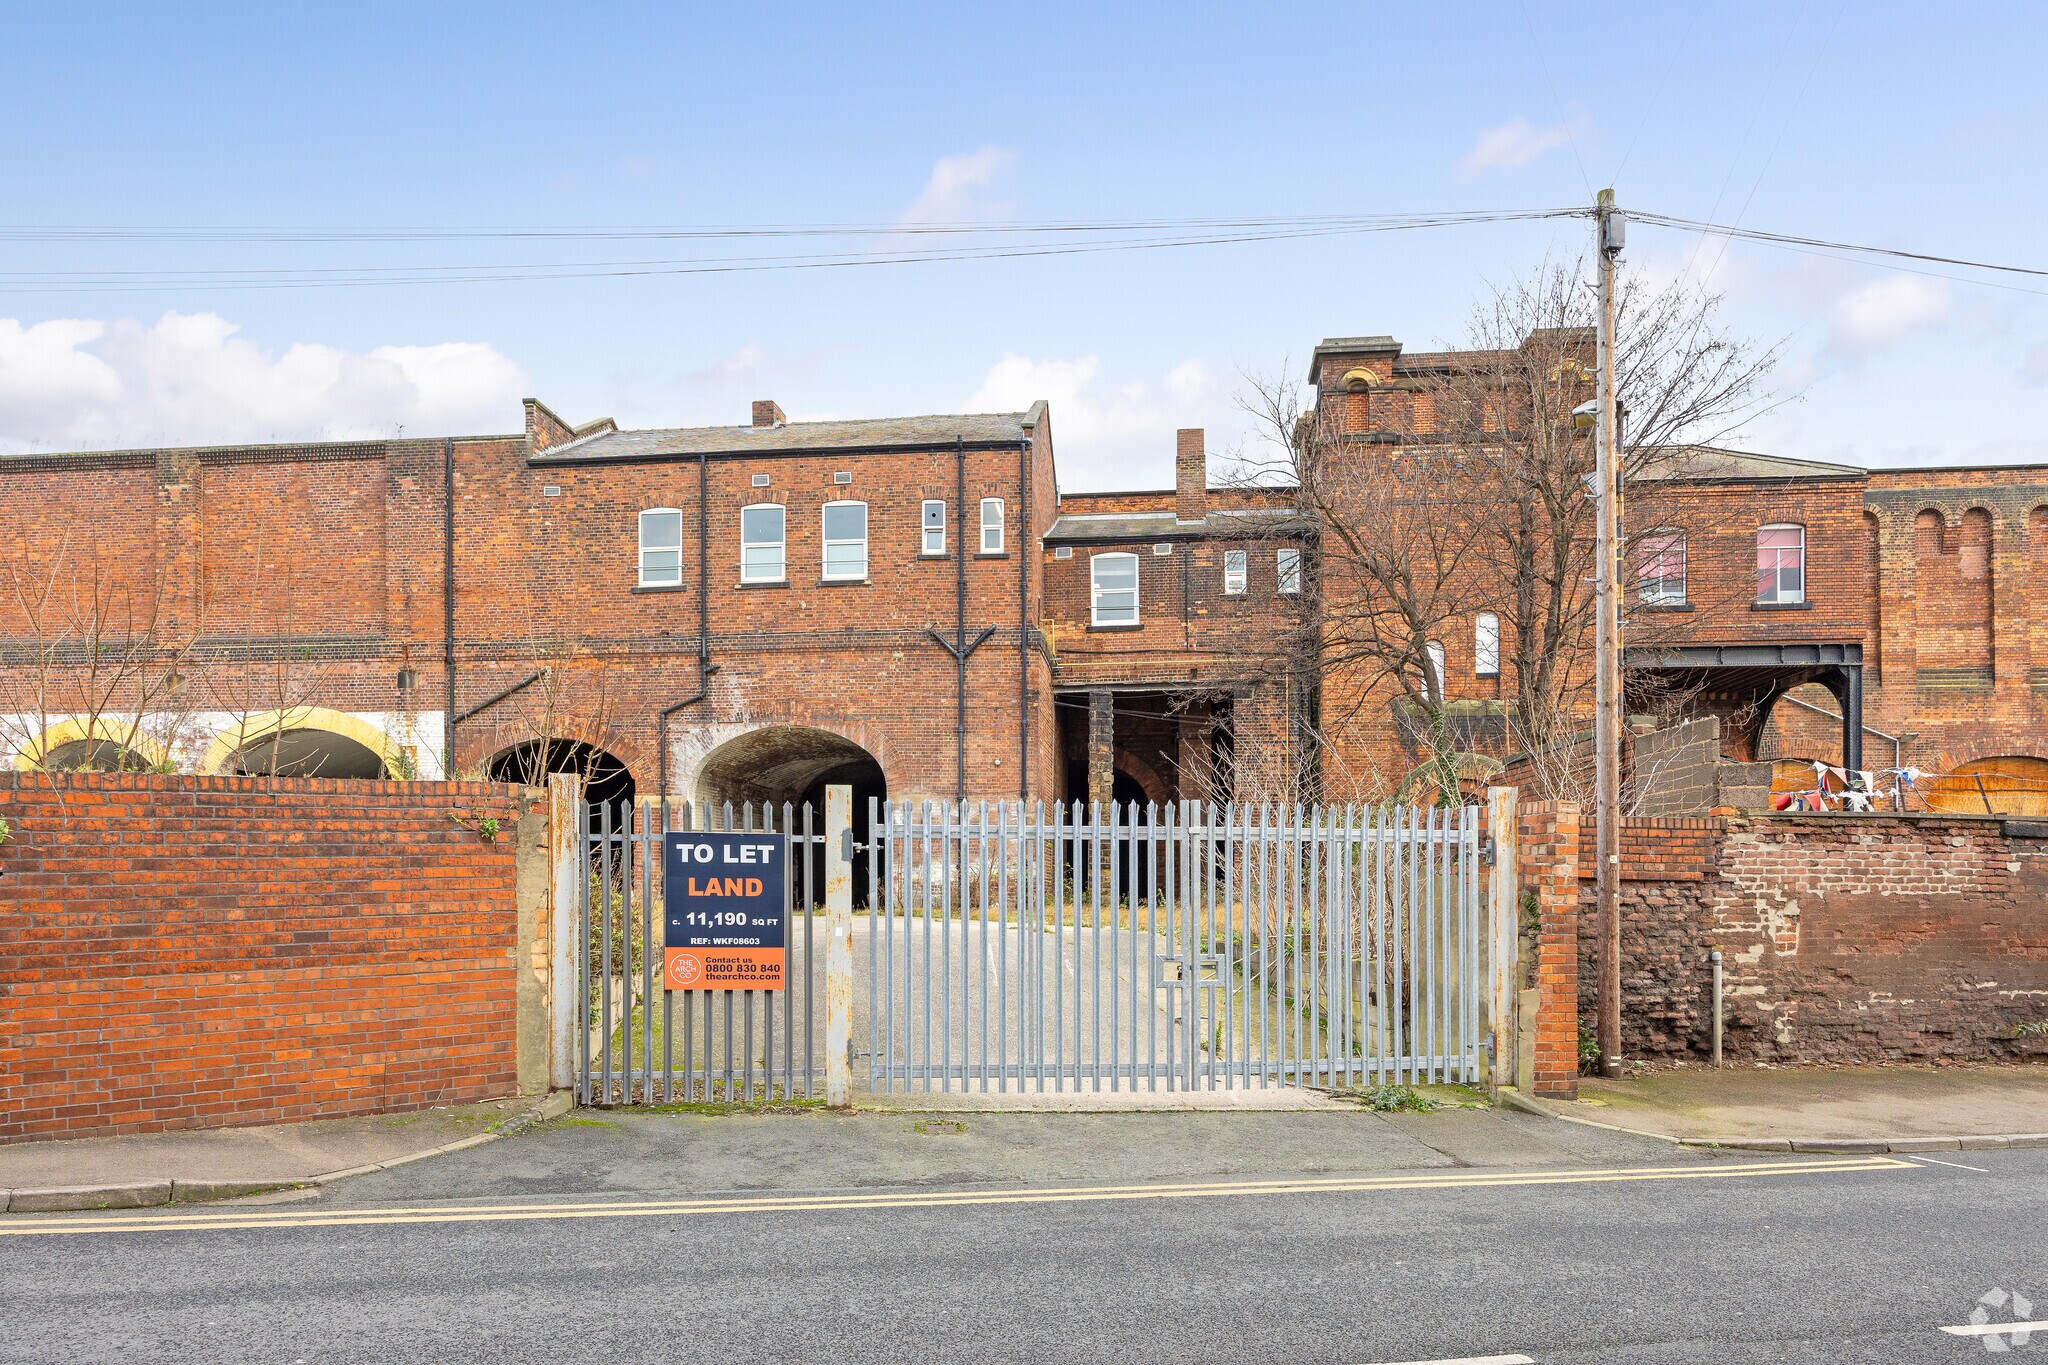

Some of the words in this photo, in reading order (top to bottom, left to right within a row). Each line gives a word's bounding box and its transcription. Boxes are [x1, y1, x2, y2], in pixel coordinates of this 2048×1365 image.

[676, 844, 714, 863] TO
[723, 845, 775, 864] LET
[688, 877, 763, 897] LAND
[686, 912, 747, 928] 11,190
[705, 964, 733, 972] 0800
[736, 964, 757, 972] 830
[760, 964, 780, 972] 840
